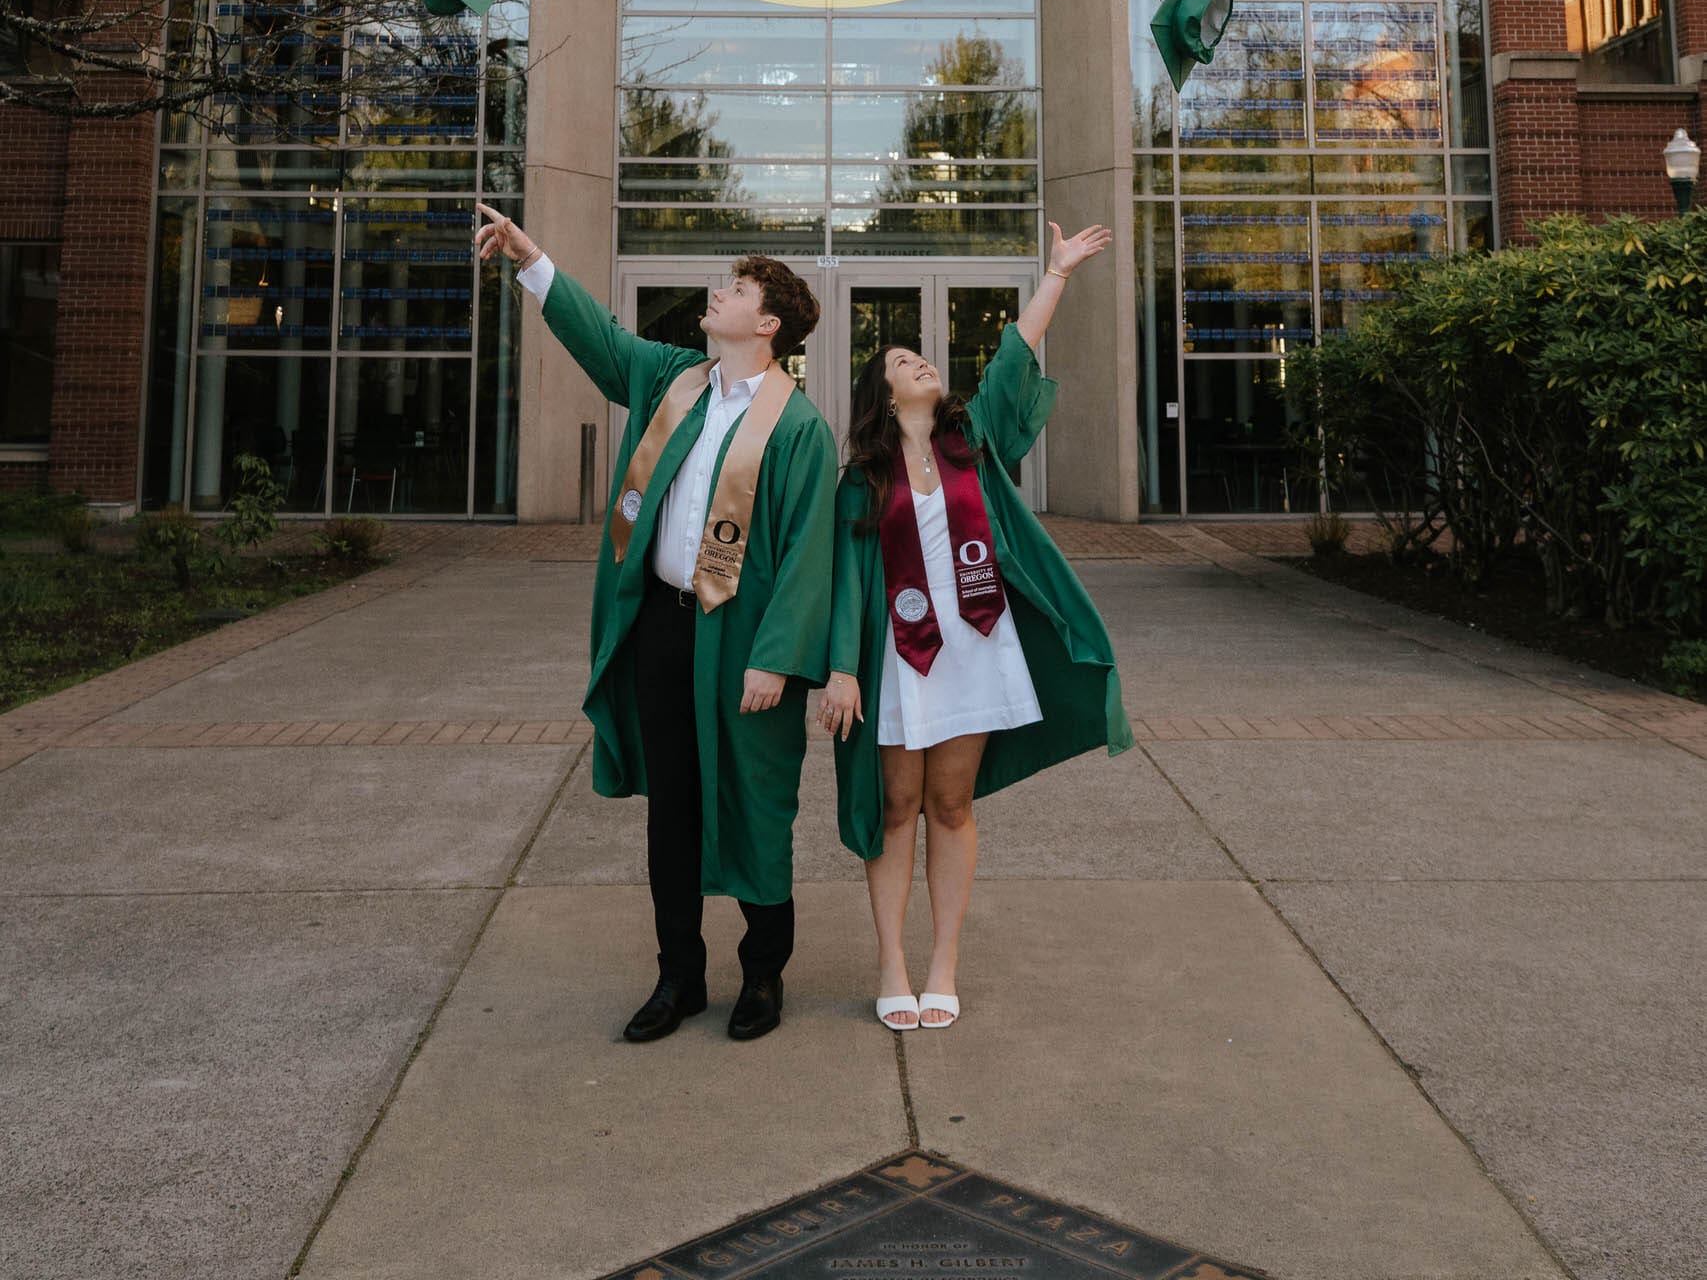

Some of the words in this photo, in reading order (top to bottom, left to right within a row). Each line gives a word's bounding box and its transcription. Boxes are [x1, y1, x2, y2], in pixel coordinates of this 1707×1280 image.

[819, 256, 837, 266] 955
[713, 520, 741, 545] O
[704, 549, 737, 563] OREGON
[959, 540, 988, 566] O
[960, 571, 994, 584] OREGON
[700, 1187, 872, 1266] GILBERT
[983, 1194, 1131, 1257] PLAZA
[831, 1258, 899, 1268] JAMES
[910, 1258, 928, 1268] H.
[939, 1258, 1026, 1268] GILBERT
